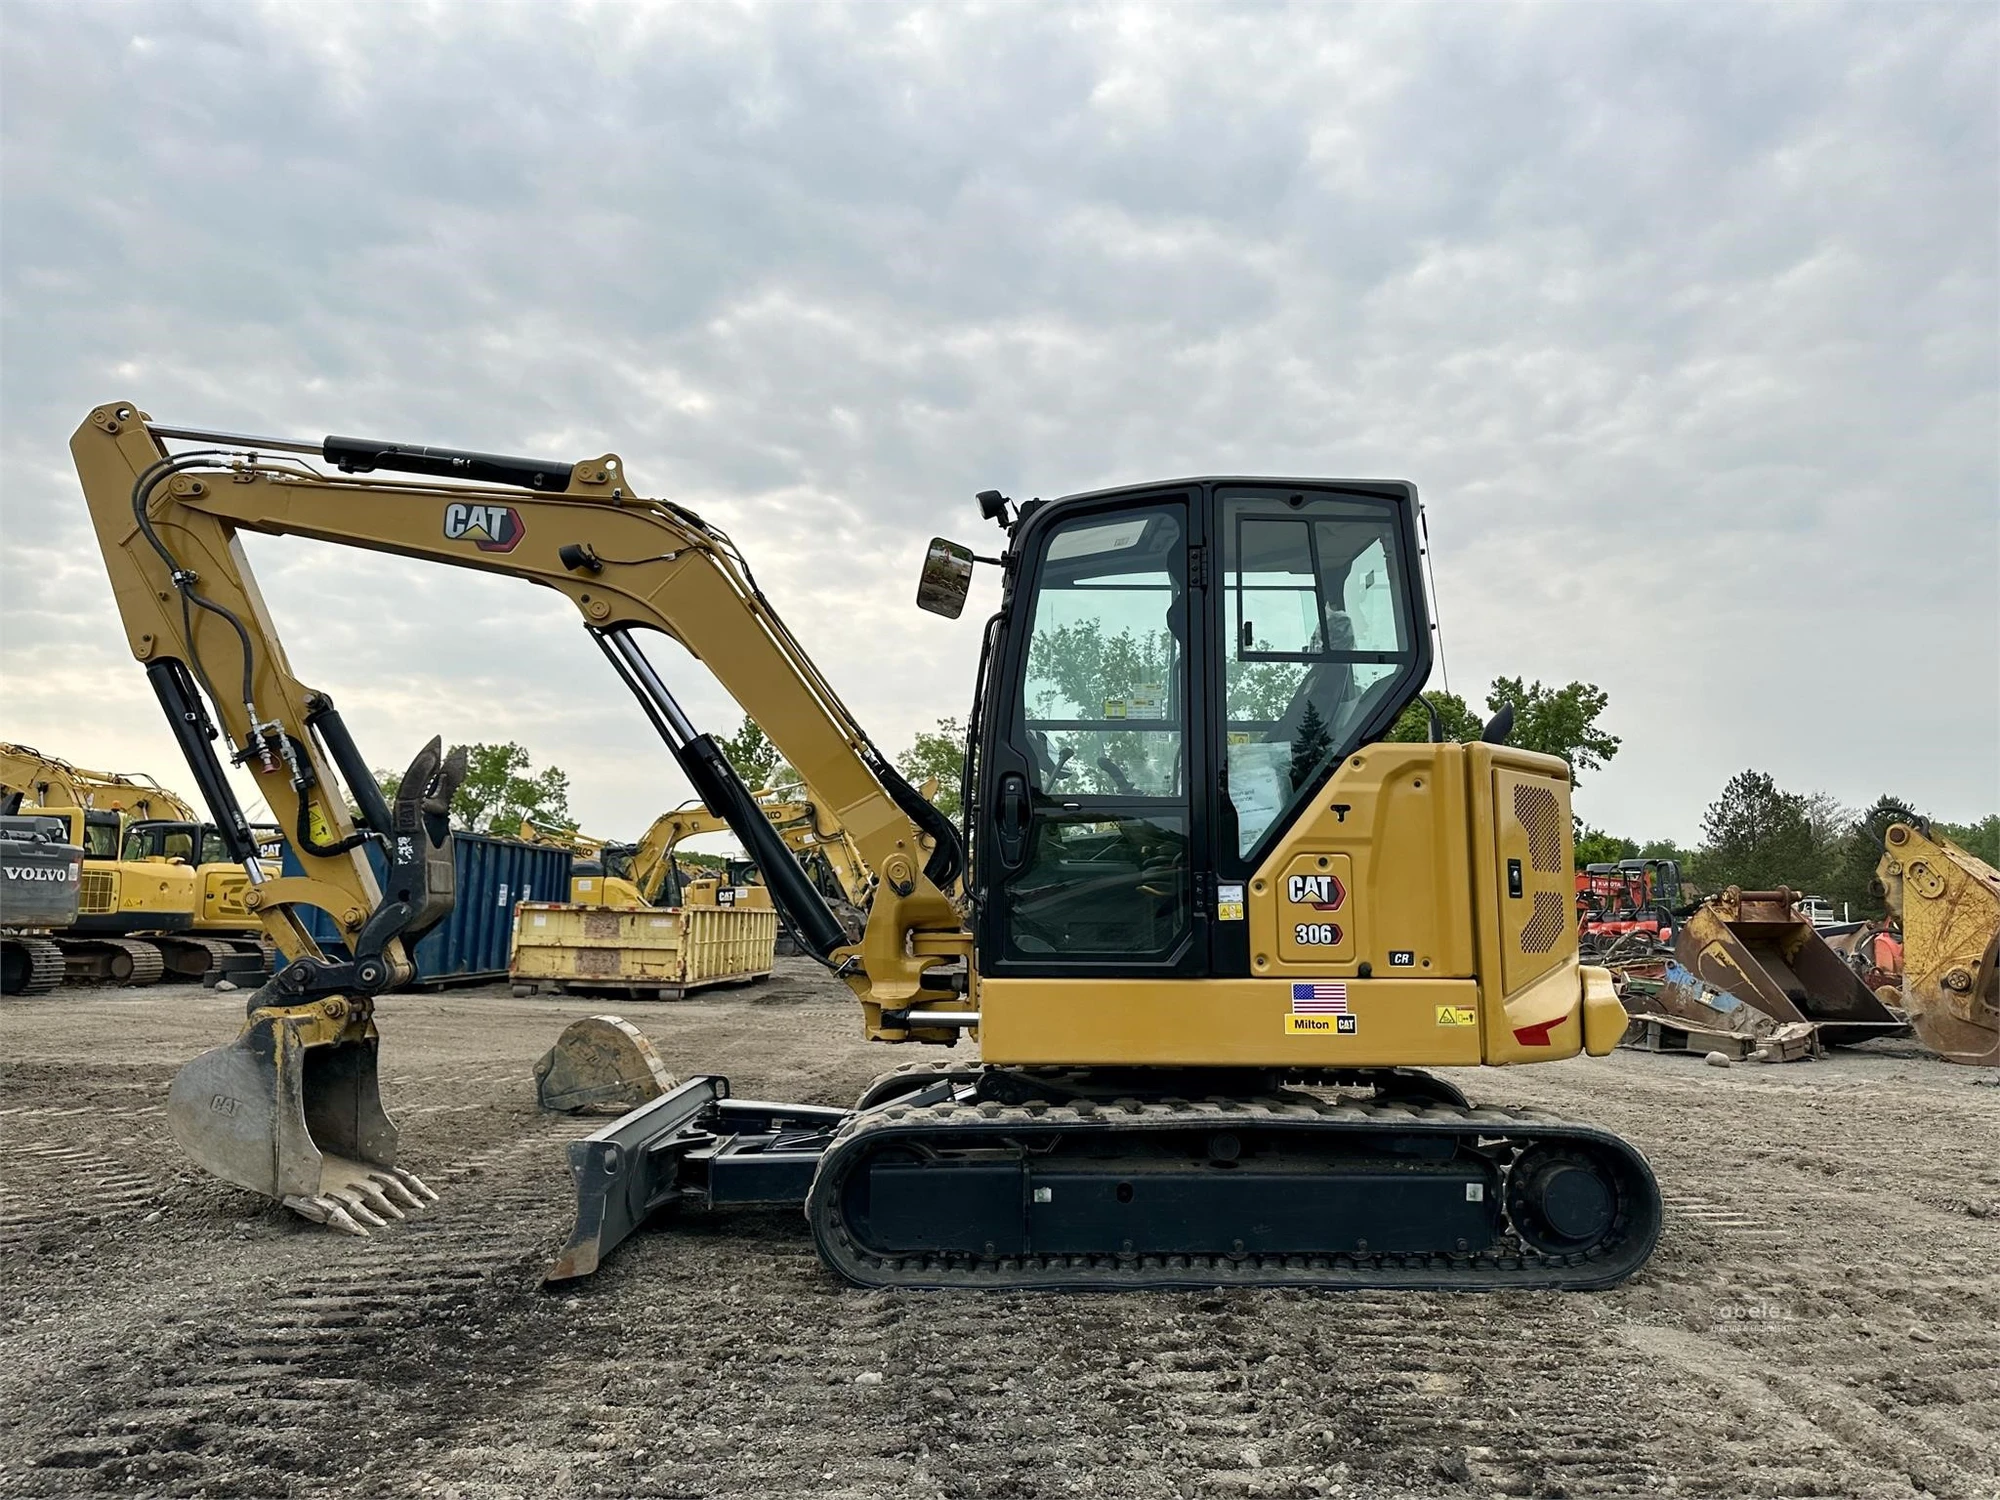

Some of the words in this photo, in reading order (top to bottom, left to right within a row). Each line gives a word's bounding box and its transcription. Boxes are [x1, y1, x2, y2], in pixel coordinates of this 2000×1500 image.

[445, 503, 507, 542] CAT
[260, 843, 281, 858] CAT
[3, 867, 66, 882] VOLVO
[719, 891, 734, 901] CAT
[1288, 875, 1331, 903] CAT
[1295, 924, 1332, 944] 306
[1394, 953, 1410, 964] CR
[1294, 1019, 1330, 1030] Milton
[1338, 1019, 1354, 1030] CAT
[210, 1094, 242, 1118] CAT
